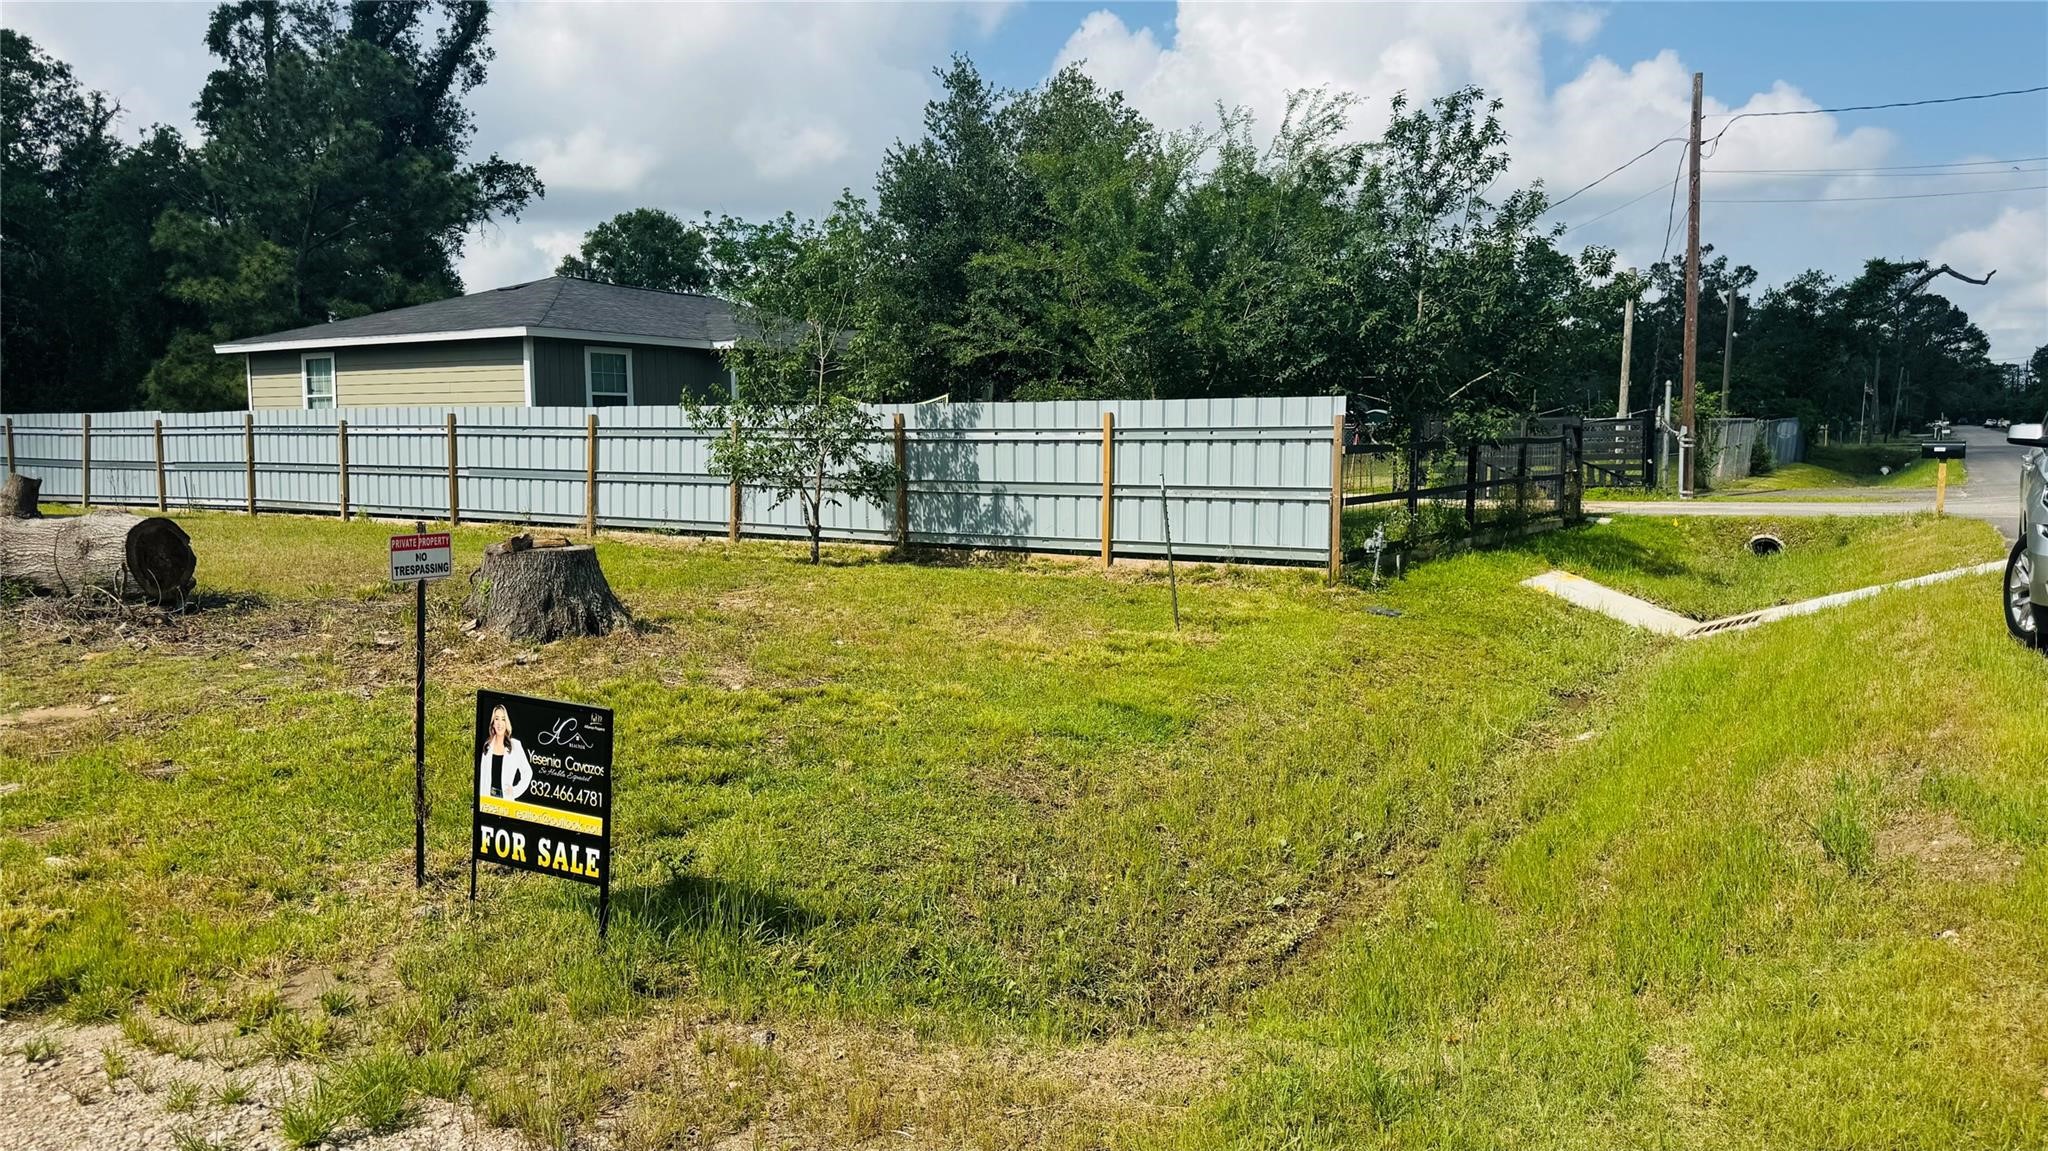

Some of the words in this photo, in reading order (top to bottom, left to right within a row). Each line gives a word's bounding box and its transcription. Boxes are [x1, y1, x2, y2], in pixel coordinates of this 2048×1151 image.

[392, 538, 417, 549] PRIVATE
[418, 536, 449, 548] PROPERTY
[415, 552, 428, 562] NO
[394, 562, 449, 577] TRESPASSING
[528, 749, 561, 769] Yesenia
[565, 756, 604, 777] Cavazos
[530, 779, 603, 808] 832.466.4781
[480, 825, 527, 862] FOR
[537, 837, 600, 878] SALE
